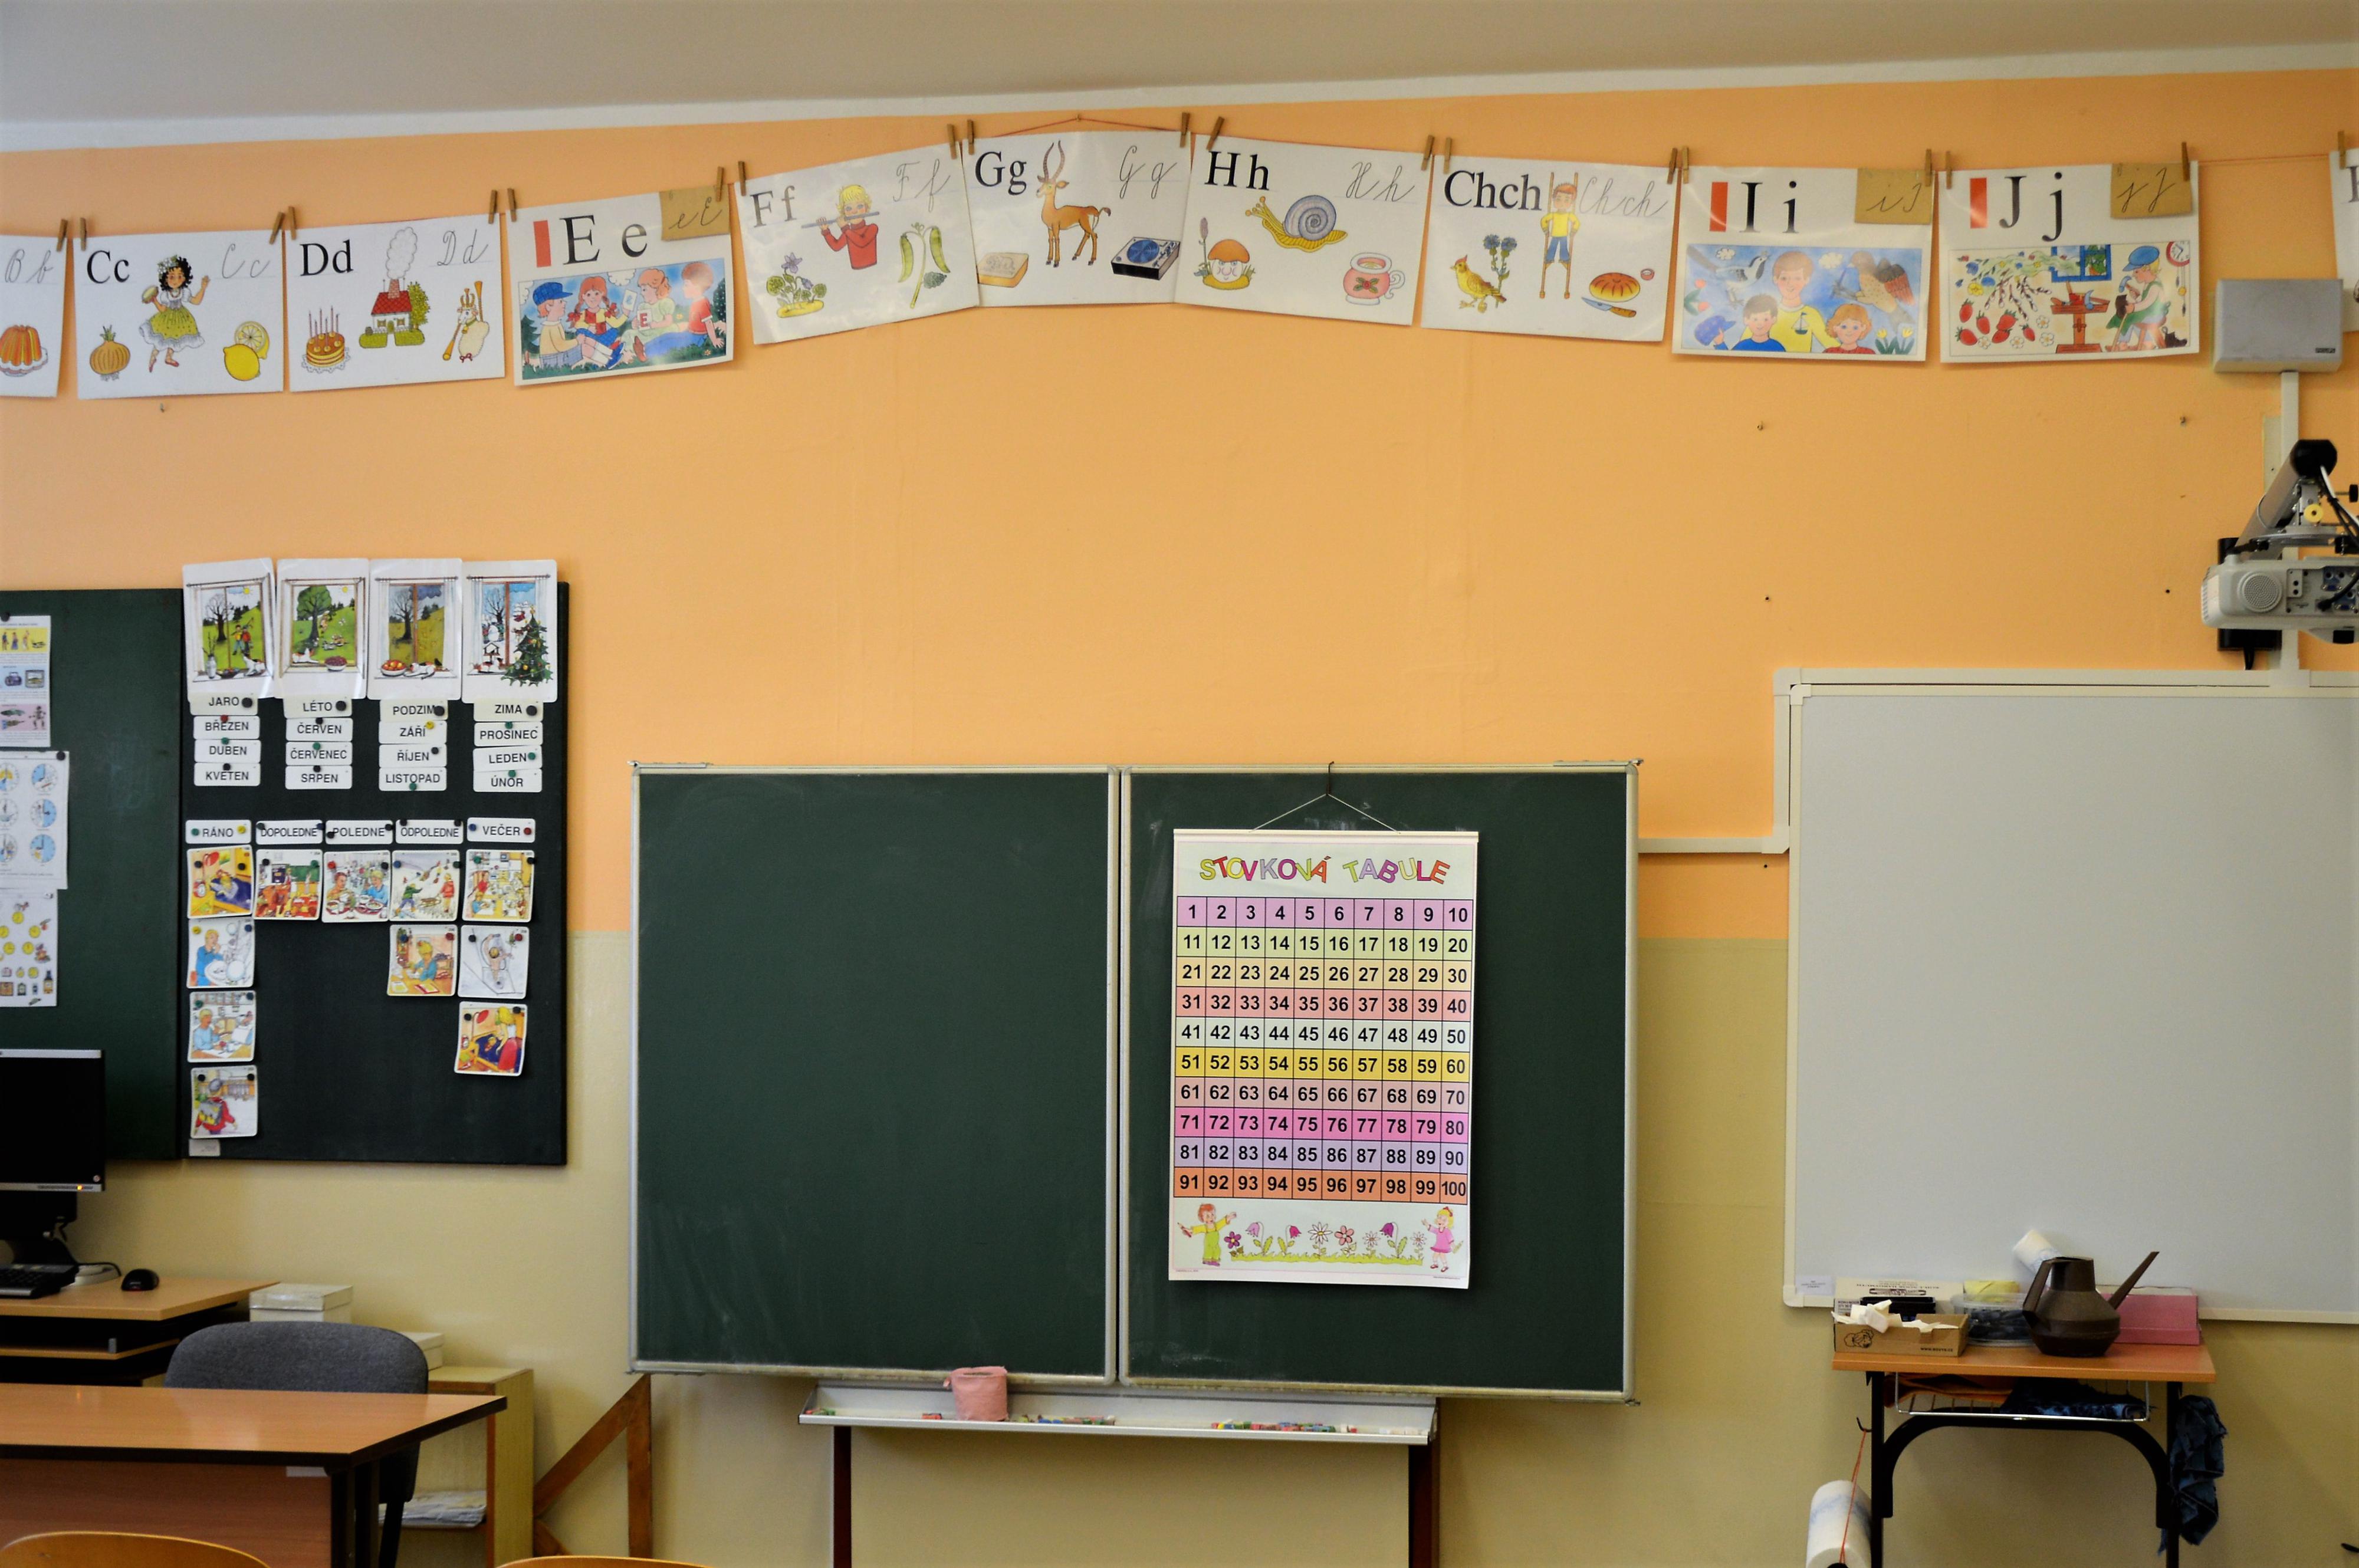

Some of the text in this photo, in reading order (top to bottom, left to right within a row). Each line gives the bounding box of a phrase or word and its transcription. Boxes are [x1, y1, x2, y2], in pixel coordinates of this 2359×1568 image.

[975, 151, 1028, 195] Gg
[1204, 150, 1272, 191] Hh
[1444, 170, 1542, 211] Chch
[299, 239, 354, 277] Dd
[86, 250, 130, 284] Cc
[640, 313, 648, 327] E
[209, 697, 239, 706] JARO
[303, 700, 333, 712] LÉTO
[393, 705, 436, 715] PODZIM
[495, 704, 523, 714] ZIMA
[205, 719, 249, 731] BŘEZEN
[297, 722, 342, 734] ČERVEN
[400, 725, 426, 737] ZÁŘÍ
[479, 729, 538, 739] PROSINEC
[209, 745, 247, 755] DUBEN
[290, 747, 347, 760] ČERVENEC
[397, 749, 429, 761] ŘÍJEN
[489, 752, 527, 764] LEDEN
[301, 774, 339, 783] SRPEN
[386, 773, 441, 784] LISTOPAD
[491, 775, 524, 787] ÚNOR
[202, 826, 234, 837] RÁNO
[261, 827, 318, 837] DOPOLEDNE
[333, 827, 385, 837] POLEDNE
[400, 827, 459, 837] ODPOLEDNE
[482, 824, 520, 836] VEČER
[1199, 855, 1451, 885] STOVKOVÁ TABULE
[1188, 904, 1468, 922] 1 2 3 4 5 6 7 8 9 10
[1184, 934, 1468, 953] 11 12 13 14 15 16 17 18 19 20
[1182, 964, 1467, 983] 21 22 23 24 25 26 27 28 29 30
[1182, 994, 1467, 1014] 31 32 33 34 35 36 37 38 39 40
[1181, 1024, 1466, 1044] 41 42 43 44 45 46 47 48 49 50
[1181, 1054, 1465, 1074] 51 52 53 54 55 56 57 58 59 60
[1181, 1084, 1465, 1105] 61 62 63 64 65 66 67 68 69 70
[1180, 1115, 1464, 1135] 71 72 73 74 75 76 77 78 79 80
[1180, 1145, 1464, 1166] 81 82 83 84 85 86 87 88 89 90
[1180, 1175, 1466, 1196] 91 92 93 94 95 96 97 98 99 100
